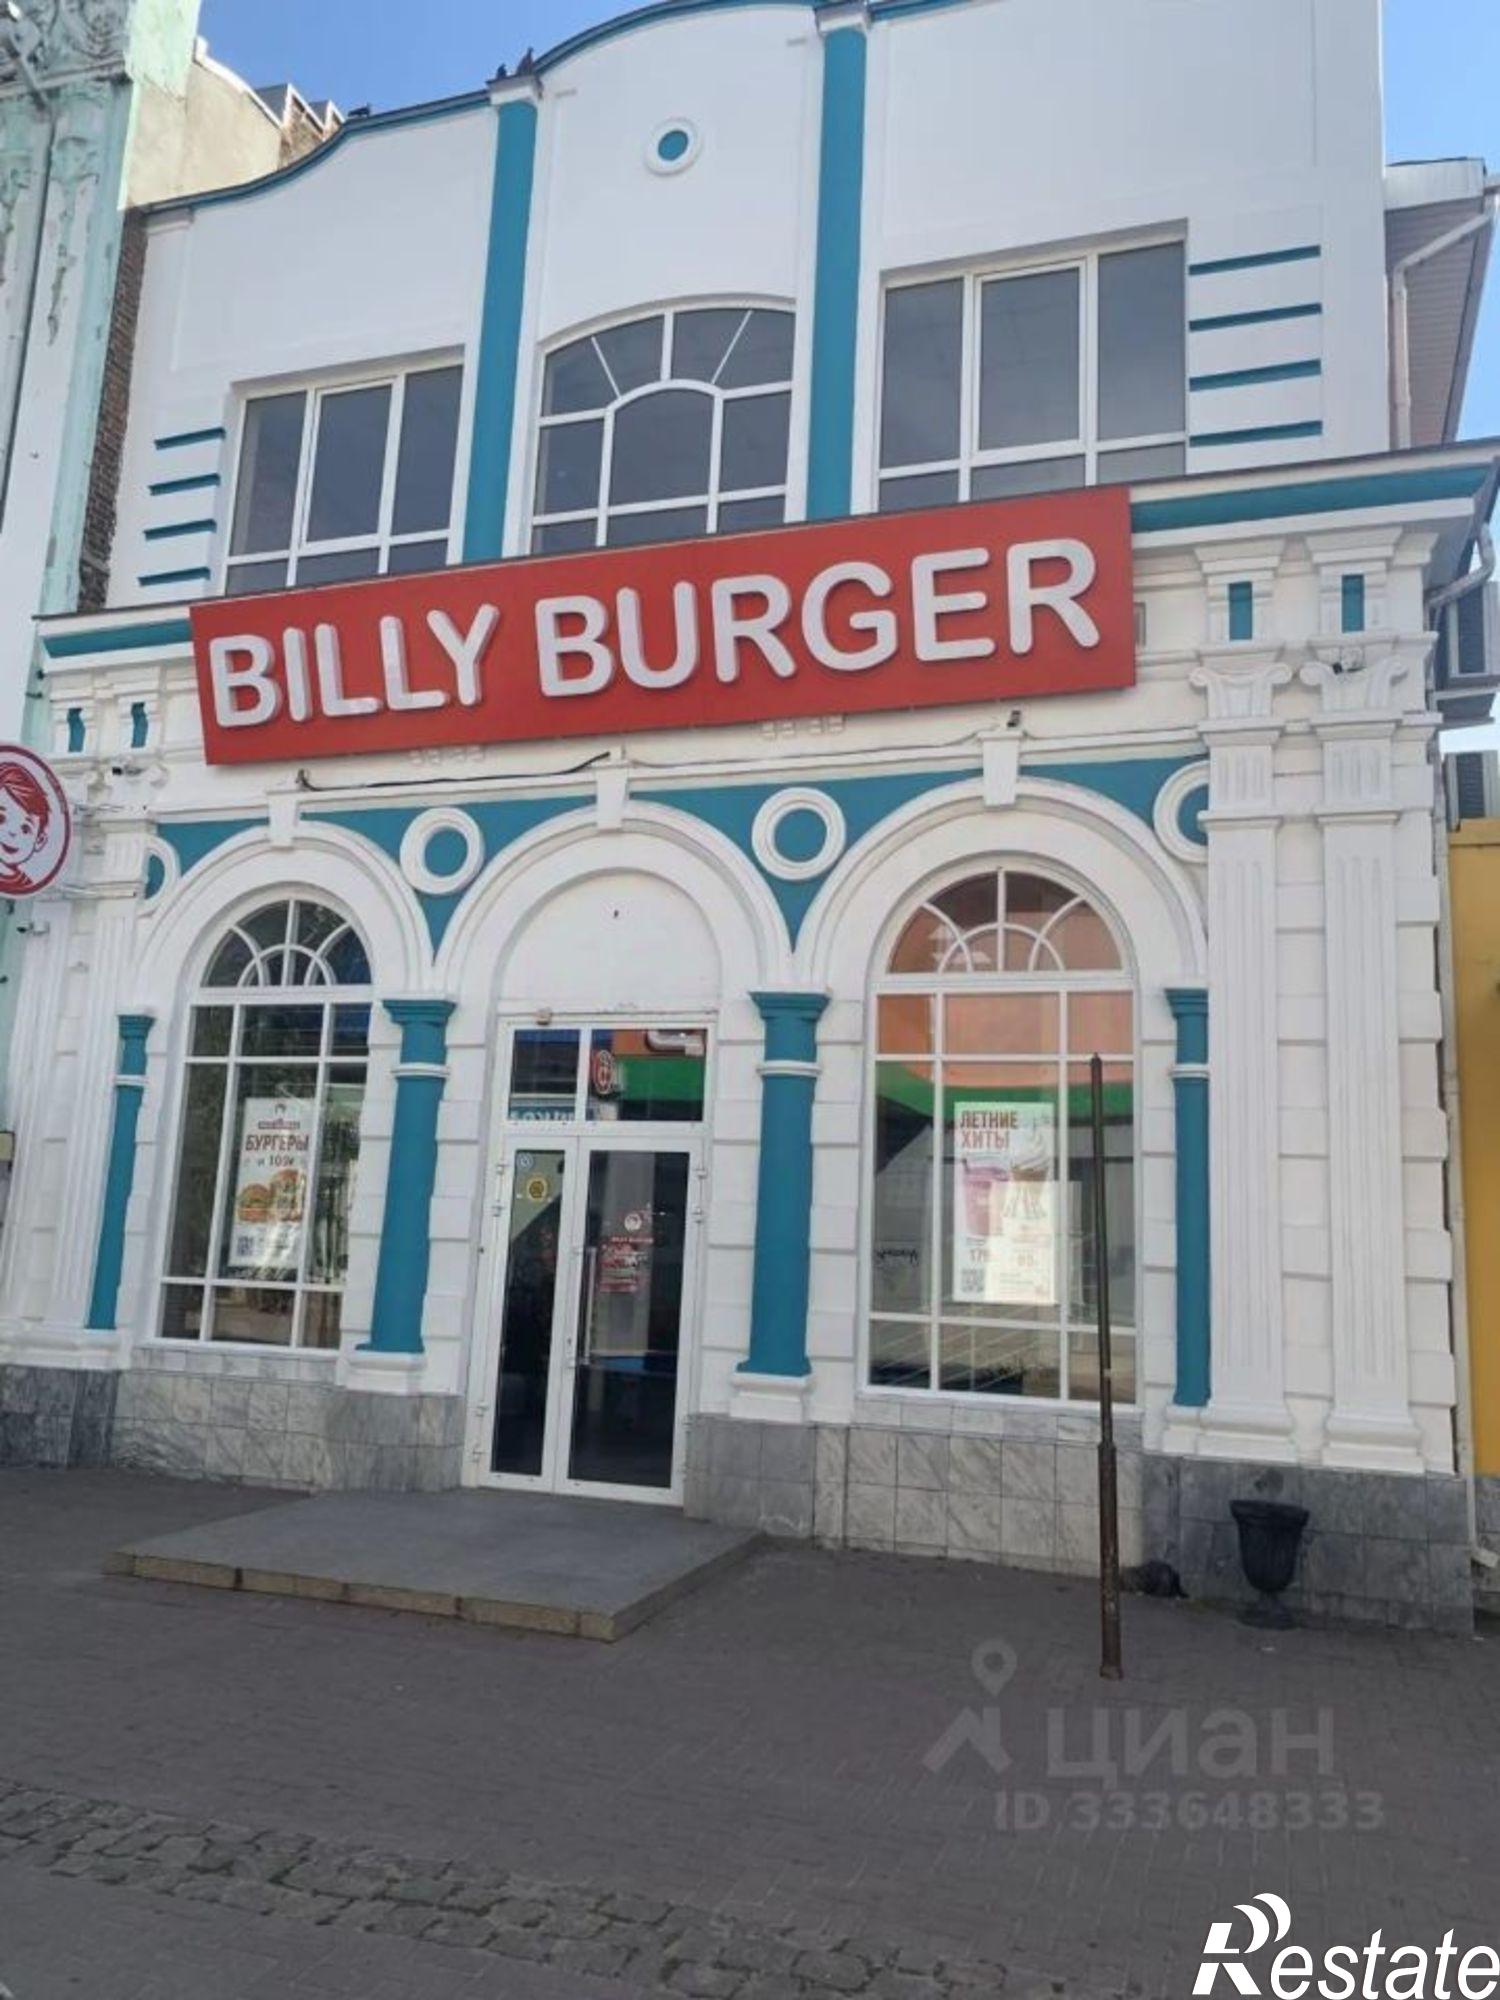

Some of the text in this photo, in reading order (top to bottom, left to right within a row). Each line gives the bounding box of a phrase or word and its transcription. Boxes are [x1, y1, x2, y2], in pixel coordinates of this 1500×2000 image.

[209, 538, 1100, 729] BILLY BURGER
[960, 1110, 1019, 1129] ЛЕТНИЕ
[245, 1134, 310, 1151] БУРГЕРЫ
[961, 1130, 1010, 1149] ХИТЫ
